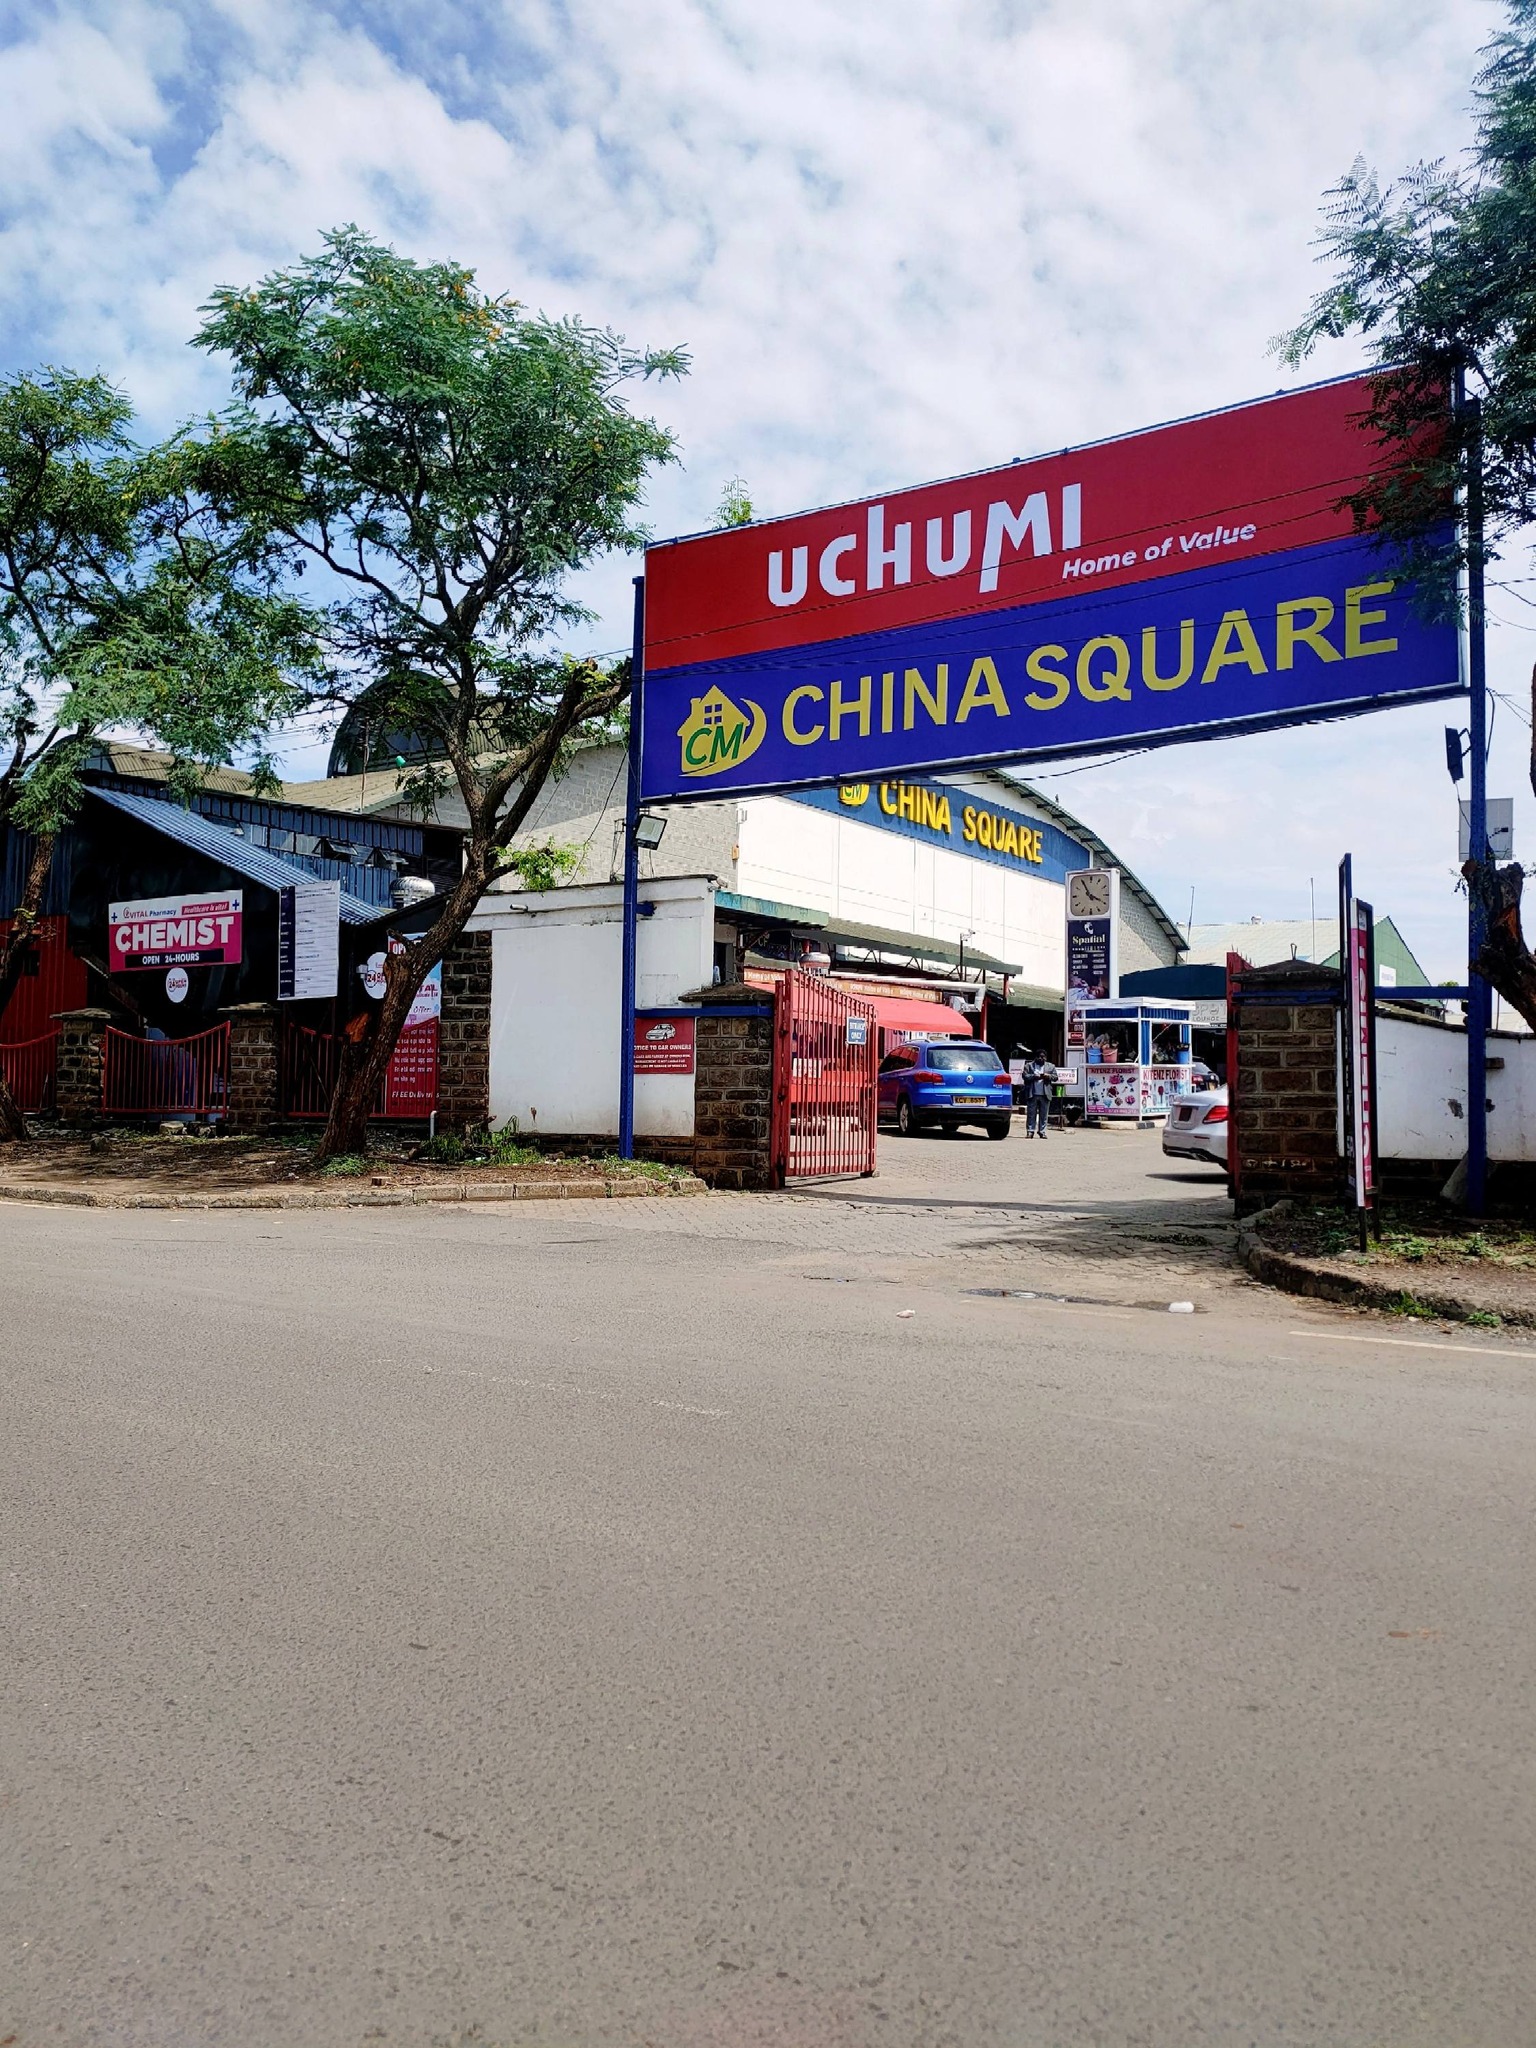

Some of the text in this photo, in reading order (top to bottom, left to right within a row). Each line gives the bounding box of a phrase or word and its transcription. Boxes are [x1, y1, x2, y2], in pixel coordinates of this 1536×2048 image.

[1062, 523, 1257, 579] Home of Value
[782, 579, 1399, 746] CHINA SQUARE
[685, 721, 744, 766] CM
[879, 780, 1043, 863] CHINA SQUARE
[130, 910, 148, 919] VITAL
[149, 909, 177, 917] Pharmacy
[115, 916, 235, 952] CHEMIST
[1072, 933, 1106, 945] Spatial
[142, 952, 200, 965] OPEN 24-HOURS
[1143, 1069, 1188, 1080] KITENZ FLORIST
